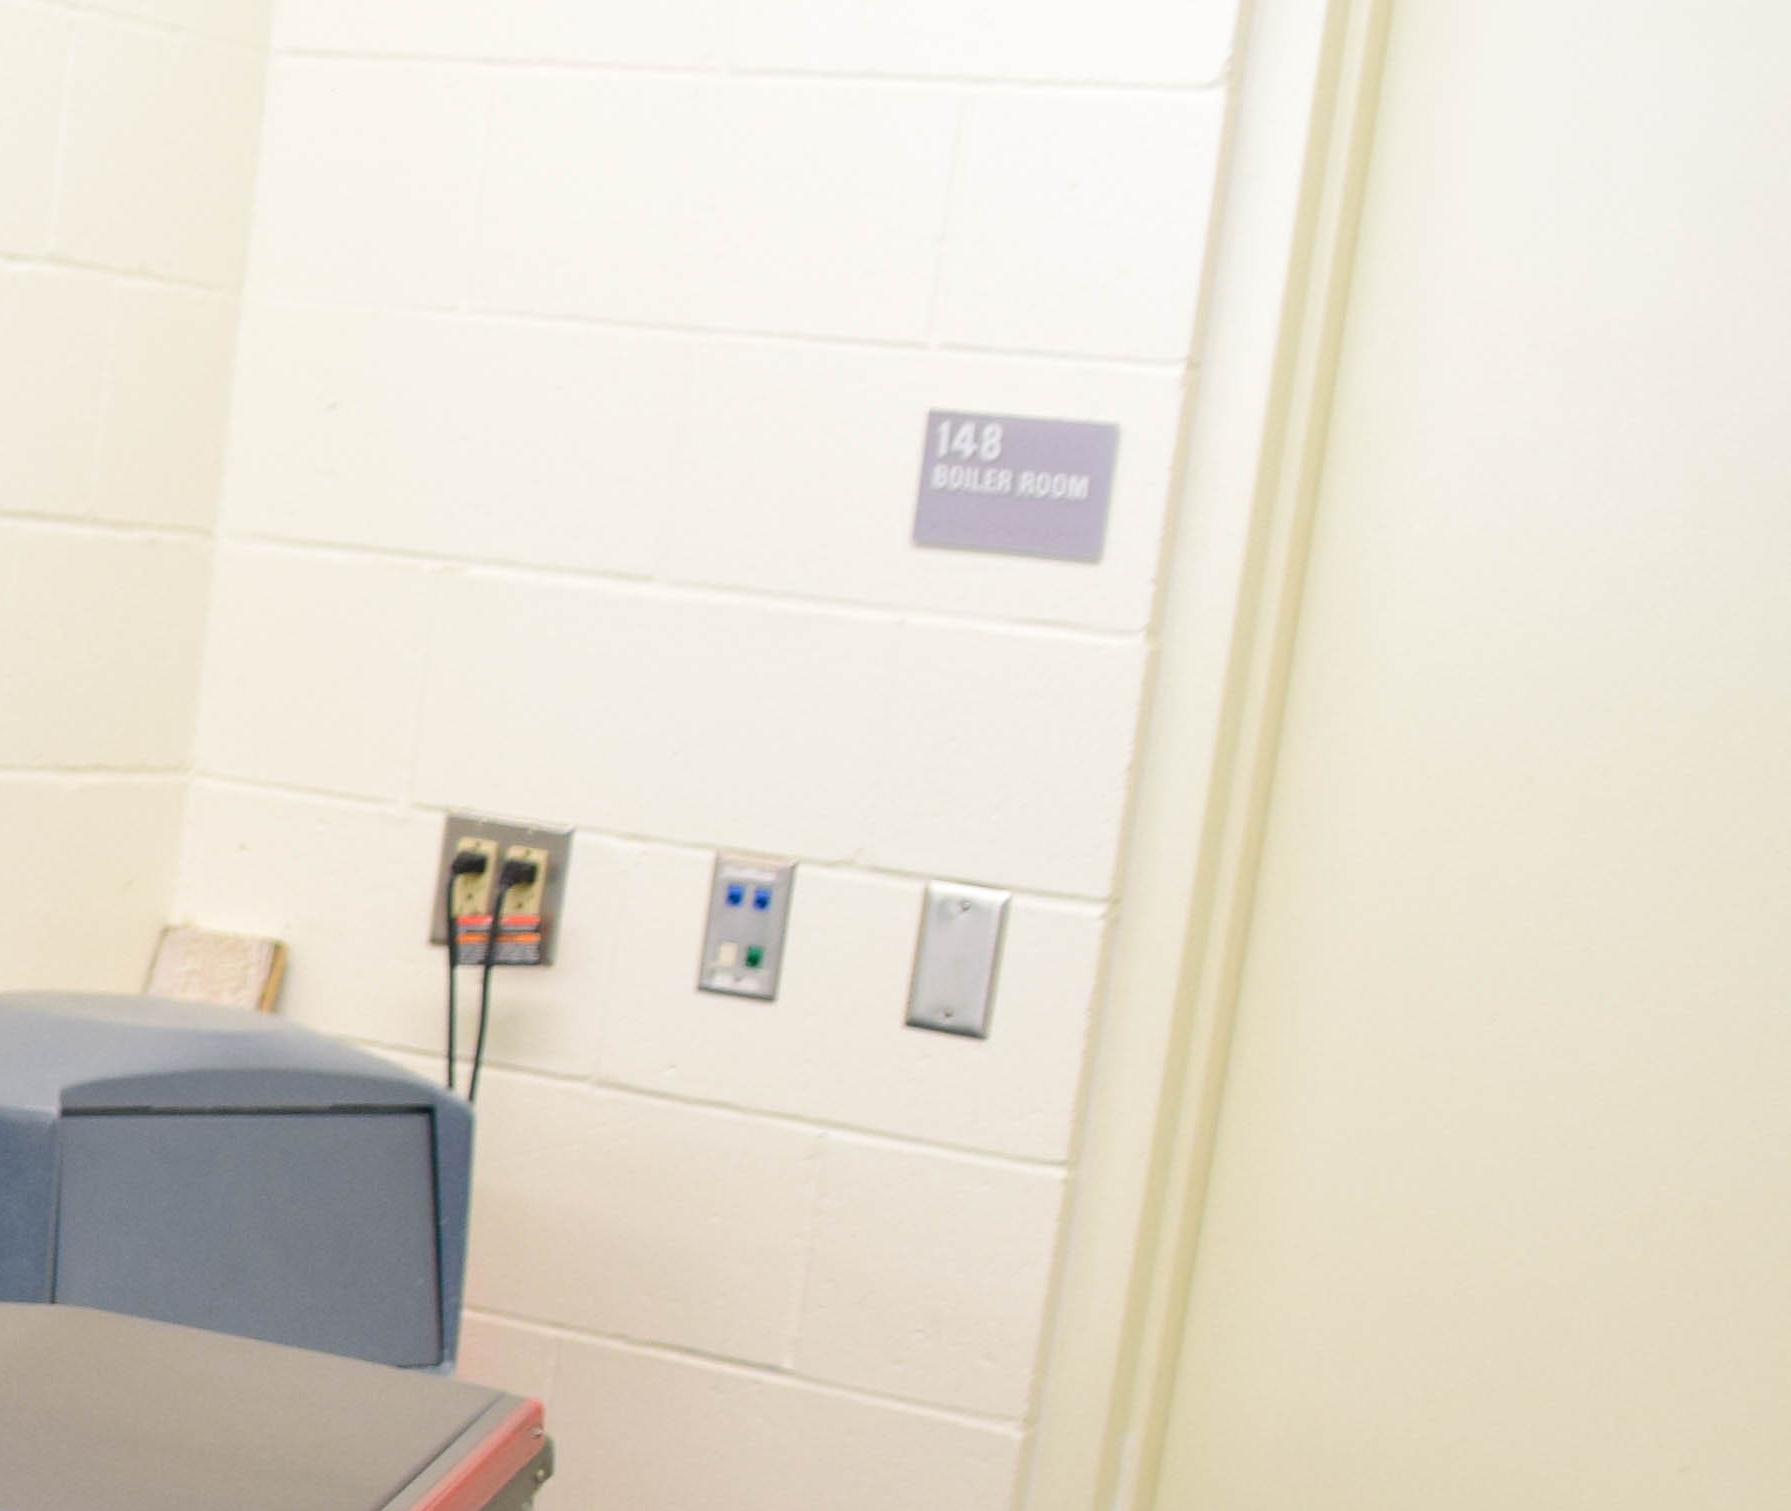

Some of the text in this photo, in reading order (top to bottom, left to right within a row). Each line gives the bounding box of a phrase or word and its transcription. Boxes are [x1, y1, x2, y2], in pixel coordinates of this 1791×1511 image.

[936, 419, 1004, 462] 148
[930, 463, 1090, 500] BOILER ROOM
